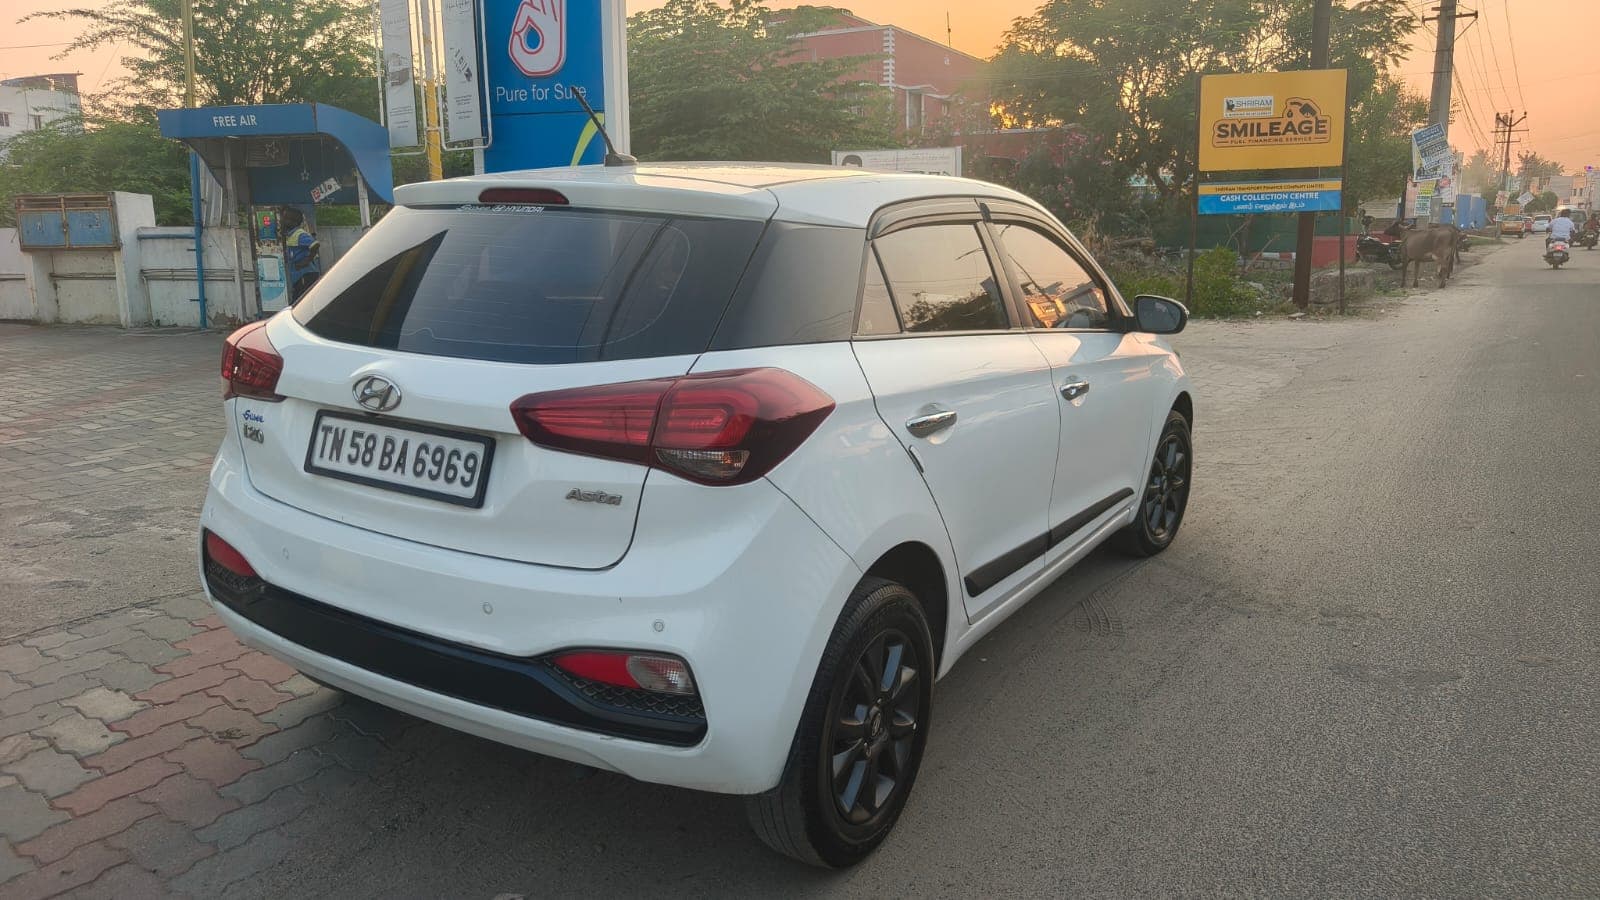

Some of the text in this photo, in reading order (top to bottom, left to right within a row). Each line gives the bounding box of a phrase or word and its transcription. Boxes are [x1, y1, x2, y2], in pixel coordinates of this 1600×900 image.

[496, 86, 528, 102] Pure
[531, 84, 549, 101] for
[1234, 99, 1273, 108] SHRIRAM
[212, 114, 257, 128] FREE AIR
[1216, 119, 1327, 138] SMILEAGE
[1220, 192, 1319, 202] CASH COLLECTION CENTRE
[319, 424, 478, 488] TN 58 BA 6969
[565, 487, 622, 506] Asta
